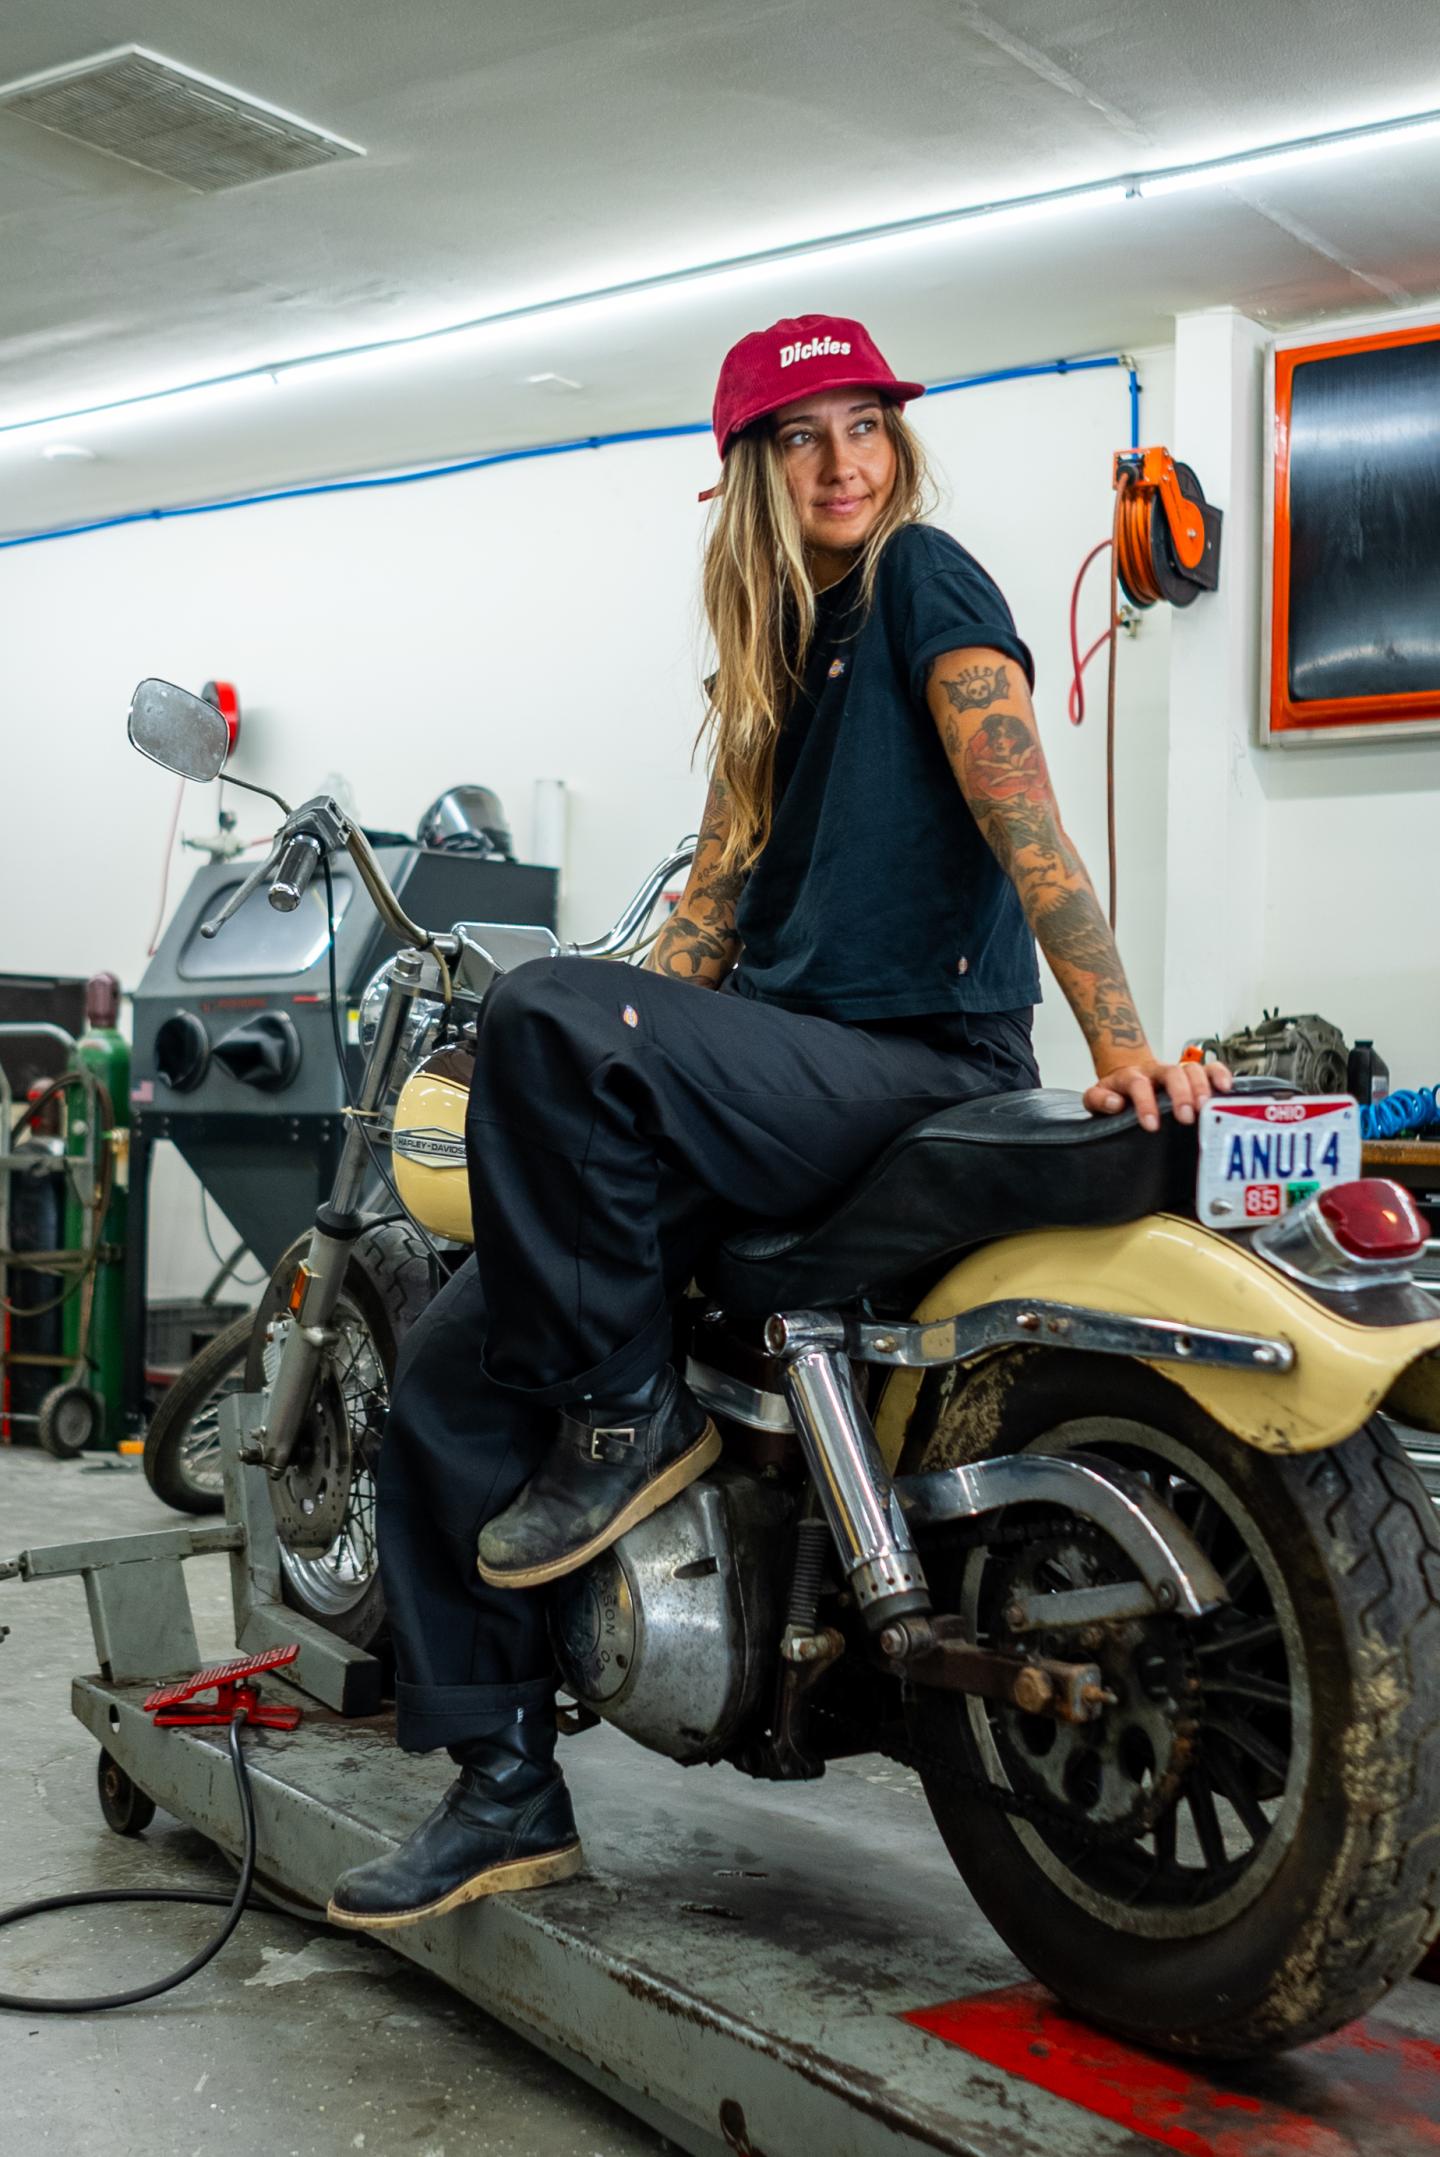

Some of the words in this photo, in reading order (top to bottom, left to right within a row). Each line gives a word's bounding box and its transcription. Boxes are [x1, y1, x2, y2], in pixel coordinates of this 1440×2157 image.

[780, 336, 851, 368] Dickies
[1265, 1105, 1306, 1121] OHIO
[398, 1138, 467, 1155] HARLEY-DAVIDS
[1226, 1131, 1339, 1181] ANU14
[1247, 1189, 1278, 1212] 85
